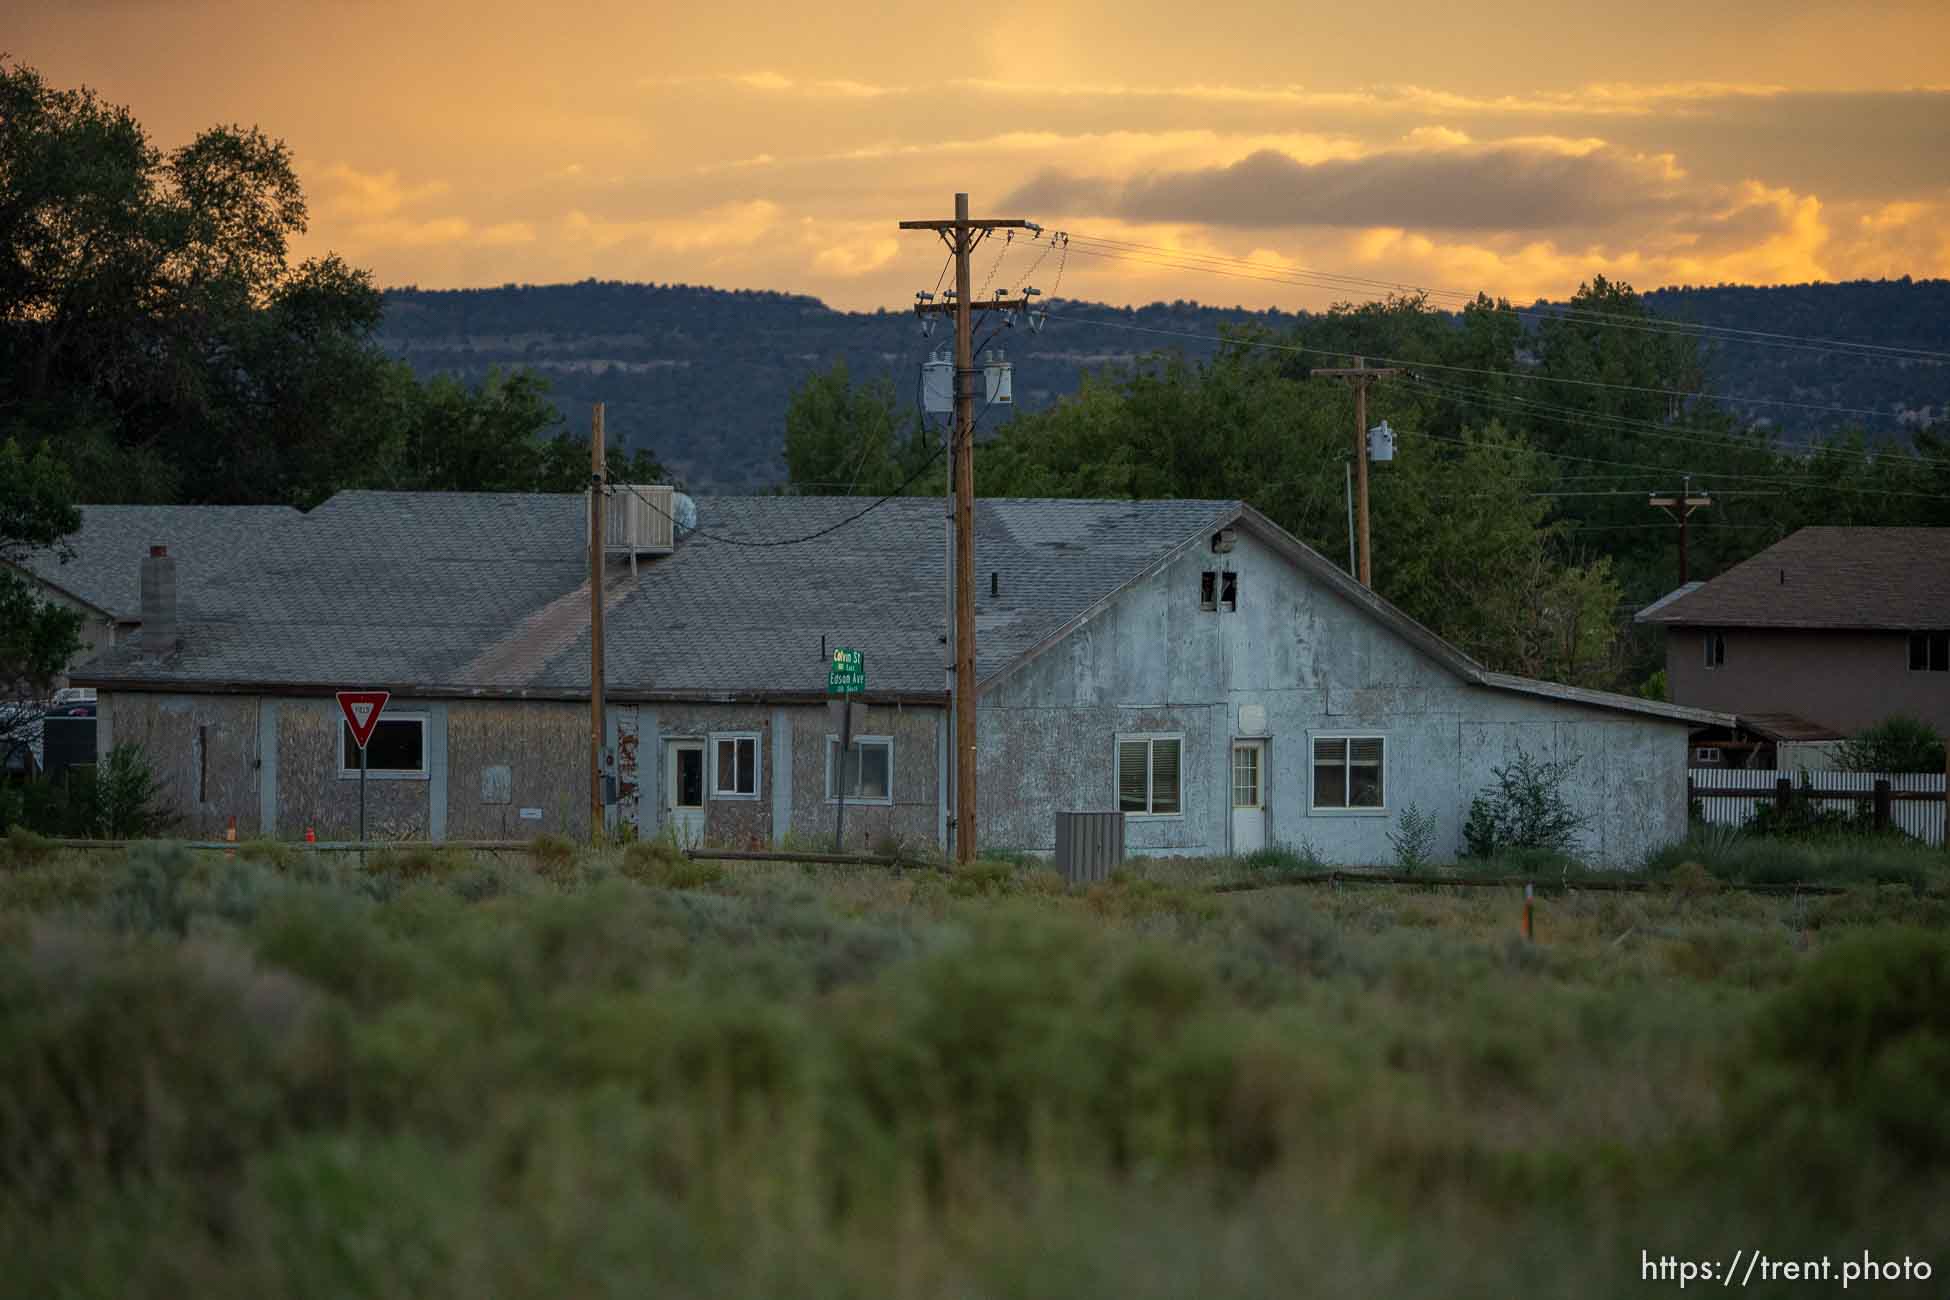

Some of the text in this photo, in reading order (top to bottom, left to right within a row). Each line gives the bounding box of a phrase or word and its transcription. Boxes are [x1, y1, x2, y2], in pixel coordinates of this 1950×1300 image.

[853, 651, 861, 664] St
[830, 672, 864, 685] Edson Ave
